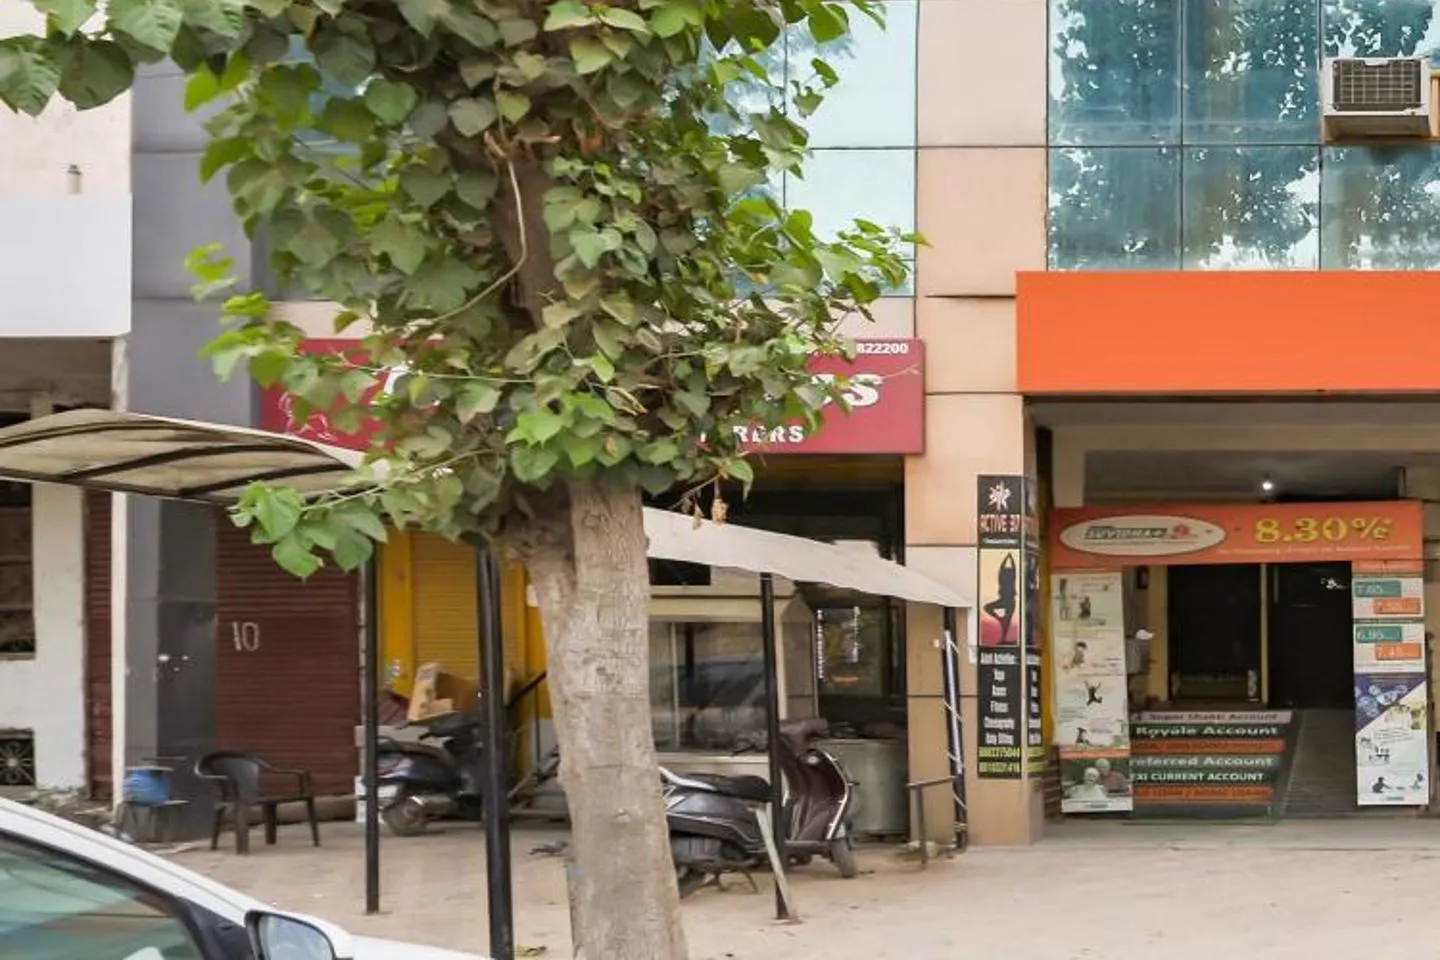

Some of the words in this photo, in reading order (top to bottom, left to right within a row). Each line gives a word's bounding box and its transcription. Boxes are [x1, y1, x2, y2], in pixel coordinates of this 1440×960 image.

[232, 621, 260, 651] 10
[1202, 726, 1279, 736] Account
[1129, 755, 1198, 767] referred
[1203, 756, 1274, 767] Account
[1151, 772, 1204, 782] CURRENT
[1207, 772, 1264, 782] ACCOUNT
